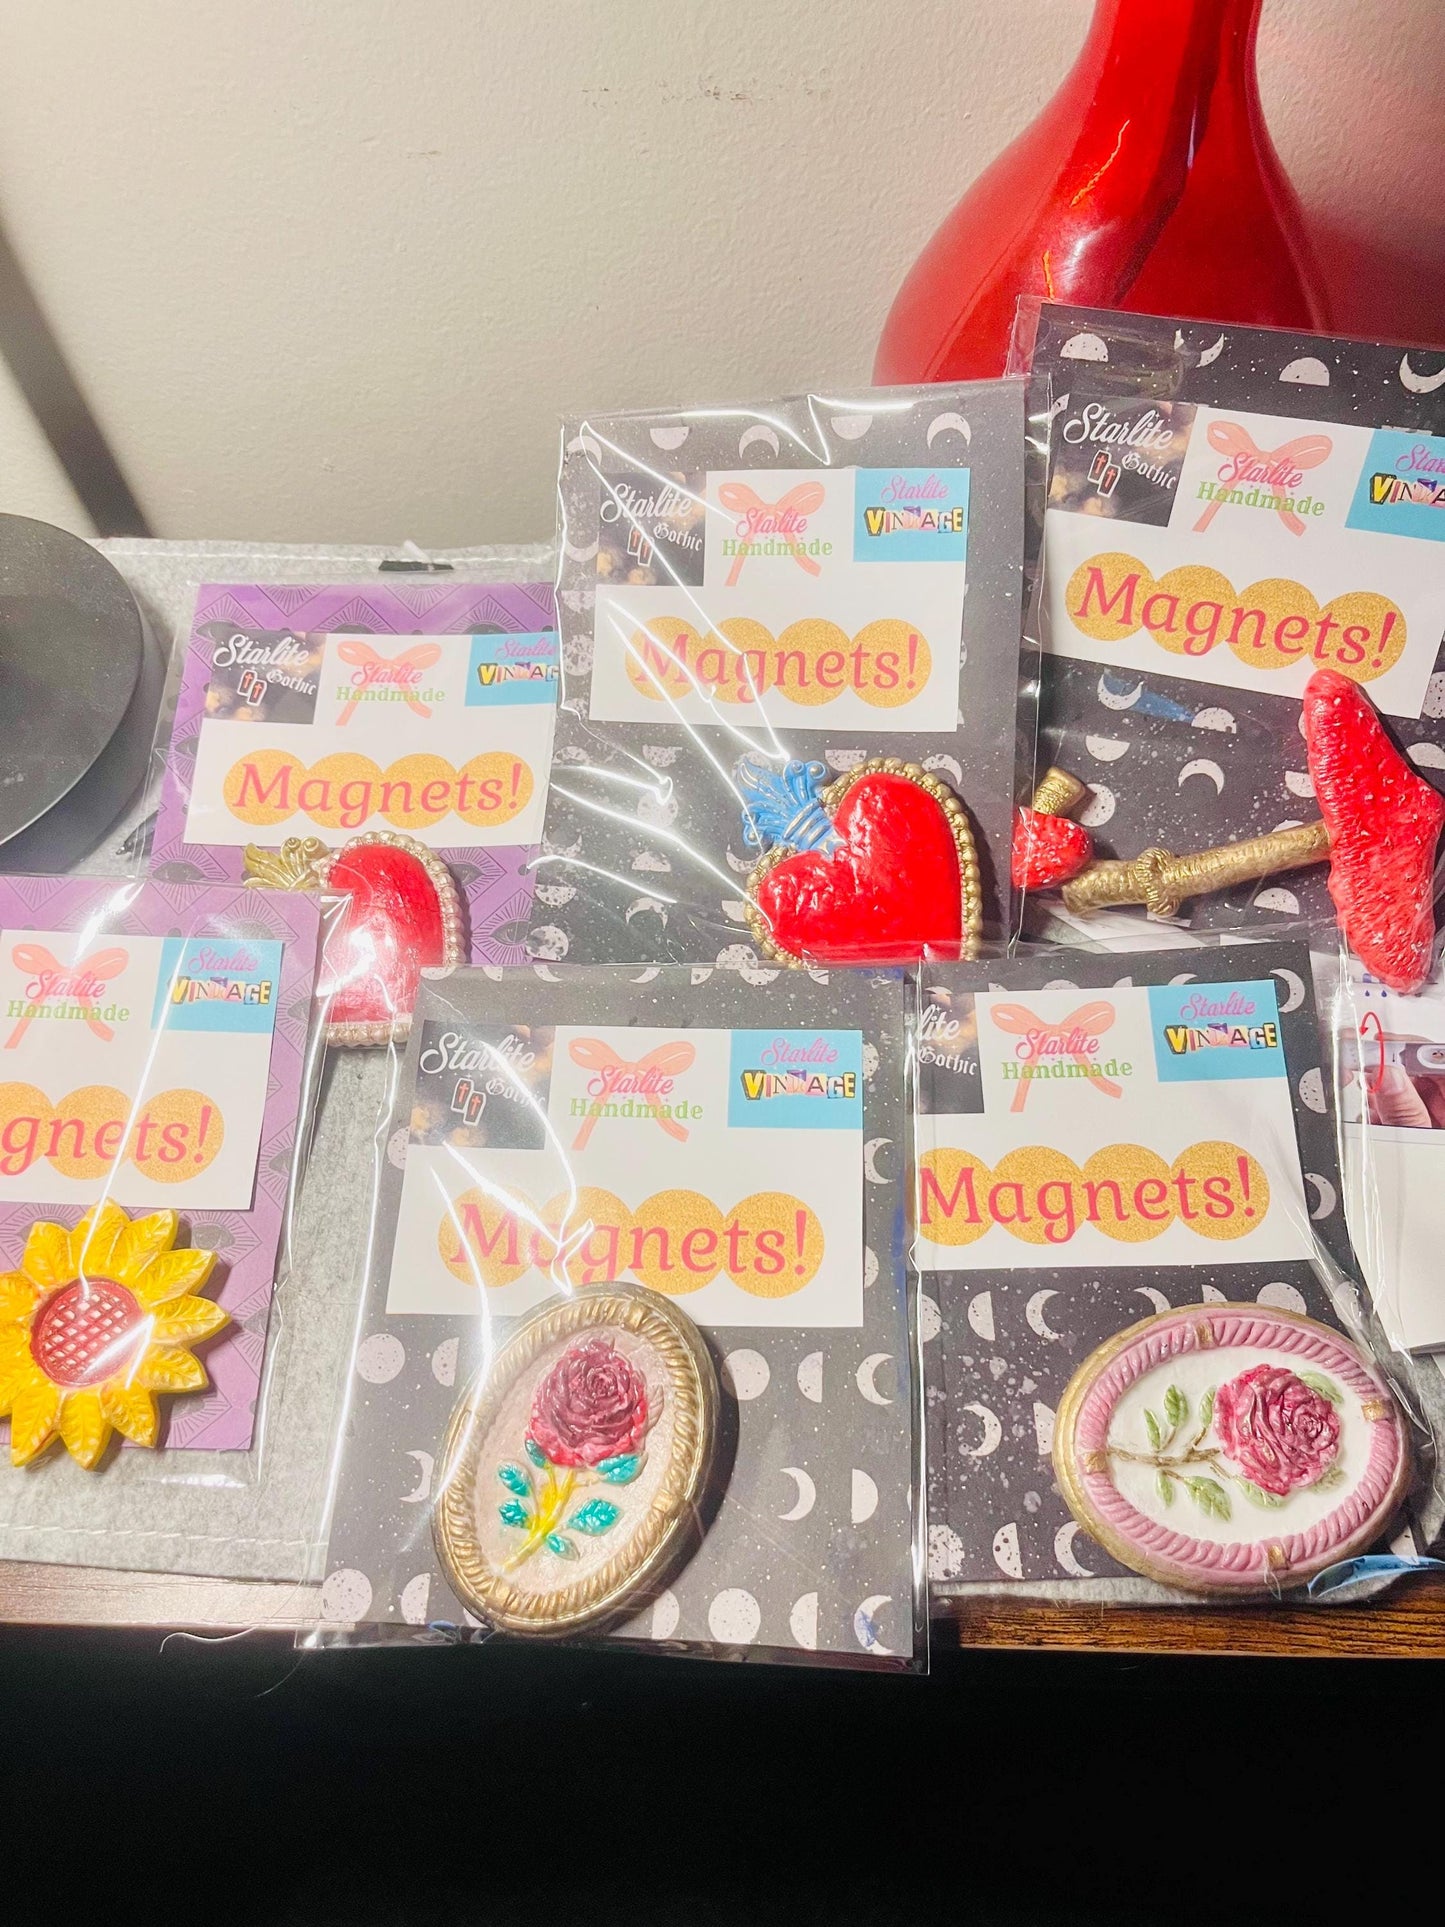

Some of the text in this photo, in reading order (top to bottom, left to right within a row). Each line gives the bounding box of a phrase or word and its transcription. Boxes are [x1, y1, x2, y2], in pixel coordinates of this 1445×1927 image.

[1063, 402, 1175, 451] Starlite
[1121, 452, 1177, 490] Gothic
[1218, 452, 1303, 489] Starlite
[1395, 443, 1445, 475] Star
[600, 483, 692, 523] Starlite
[881, 473, 949, 503] Starlite
[1197, 481, 1326, 517] Handmade
[653, 522, 704, 552] Gothic
[735, 507, 809, 539] Starlite
[864, 506, 964, 537] VINTAGE
[722, 538, 833, 557] Handmade
[1073, 566, 1397, 669] Magnets!
[213, 633, 311, 669] Starlite
[266, 668, 316, 696] Gothic
[350, 661, 424, 688] Starlite
[478, 661, 559, 686] VINTAG
[634, 633, 920, 704] Magnets!
[335, 685, 446, 703] Handmade
[232, 762, 522, 829] Magnets!
[187, 947, 259, 973] Starlite
[26, 969, 106, 999] Starlite
[168, 976, 272, 1005] VINTAGE
[7, 1000, 130, 1022] Handmade
[1179, 991, 1257, 1021] Starlite
[915, 1004, 961, 1041] lite
[1165, 1022, 1279, 1055] VINTAGE
[419, 1032, 536, 1075] Starlite
[760, 1037, 838, 1066] Starlite
[1015, 1027, 1101, 1059] Starlite
[587, 1065, 675, 1097] Starlite
[740, 1069, 857, 1102] VINTAGE
[1001, 1059, 1133, 1080] Handmade
[569, 1098, 704, 1121] Handmade
[0, 1105, 212, 1176] gnets!
[920, 1156, 1257, 1244] Magnets!
[448, 1203, 807, 1286] Magnets!
